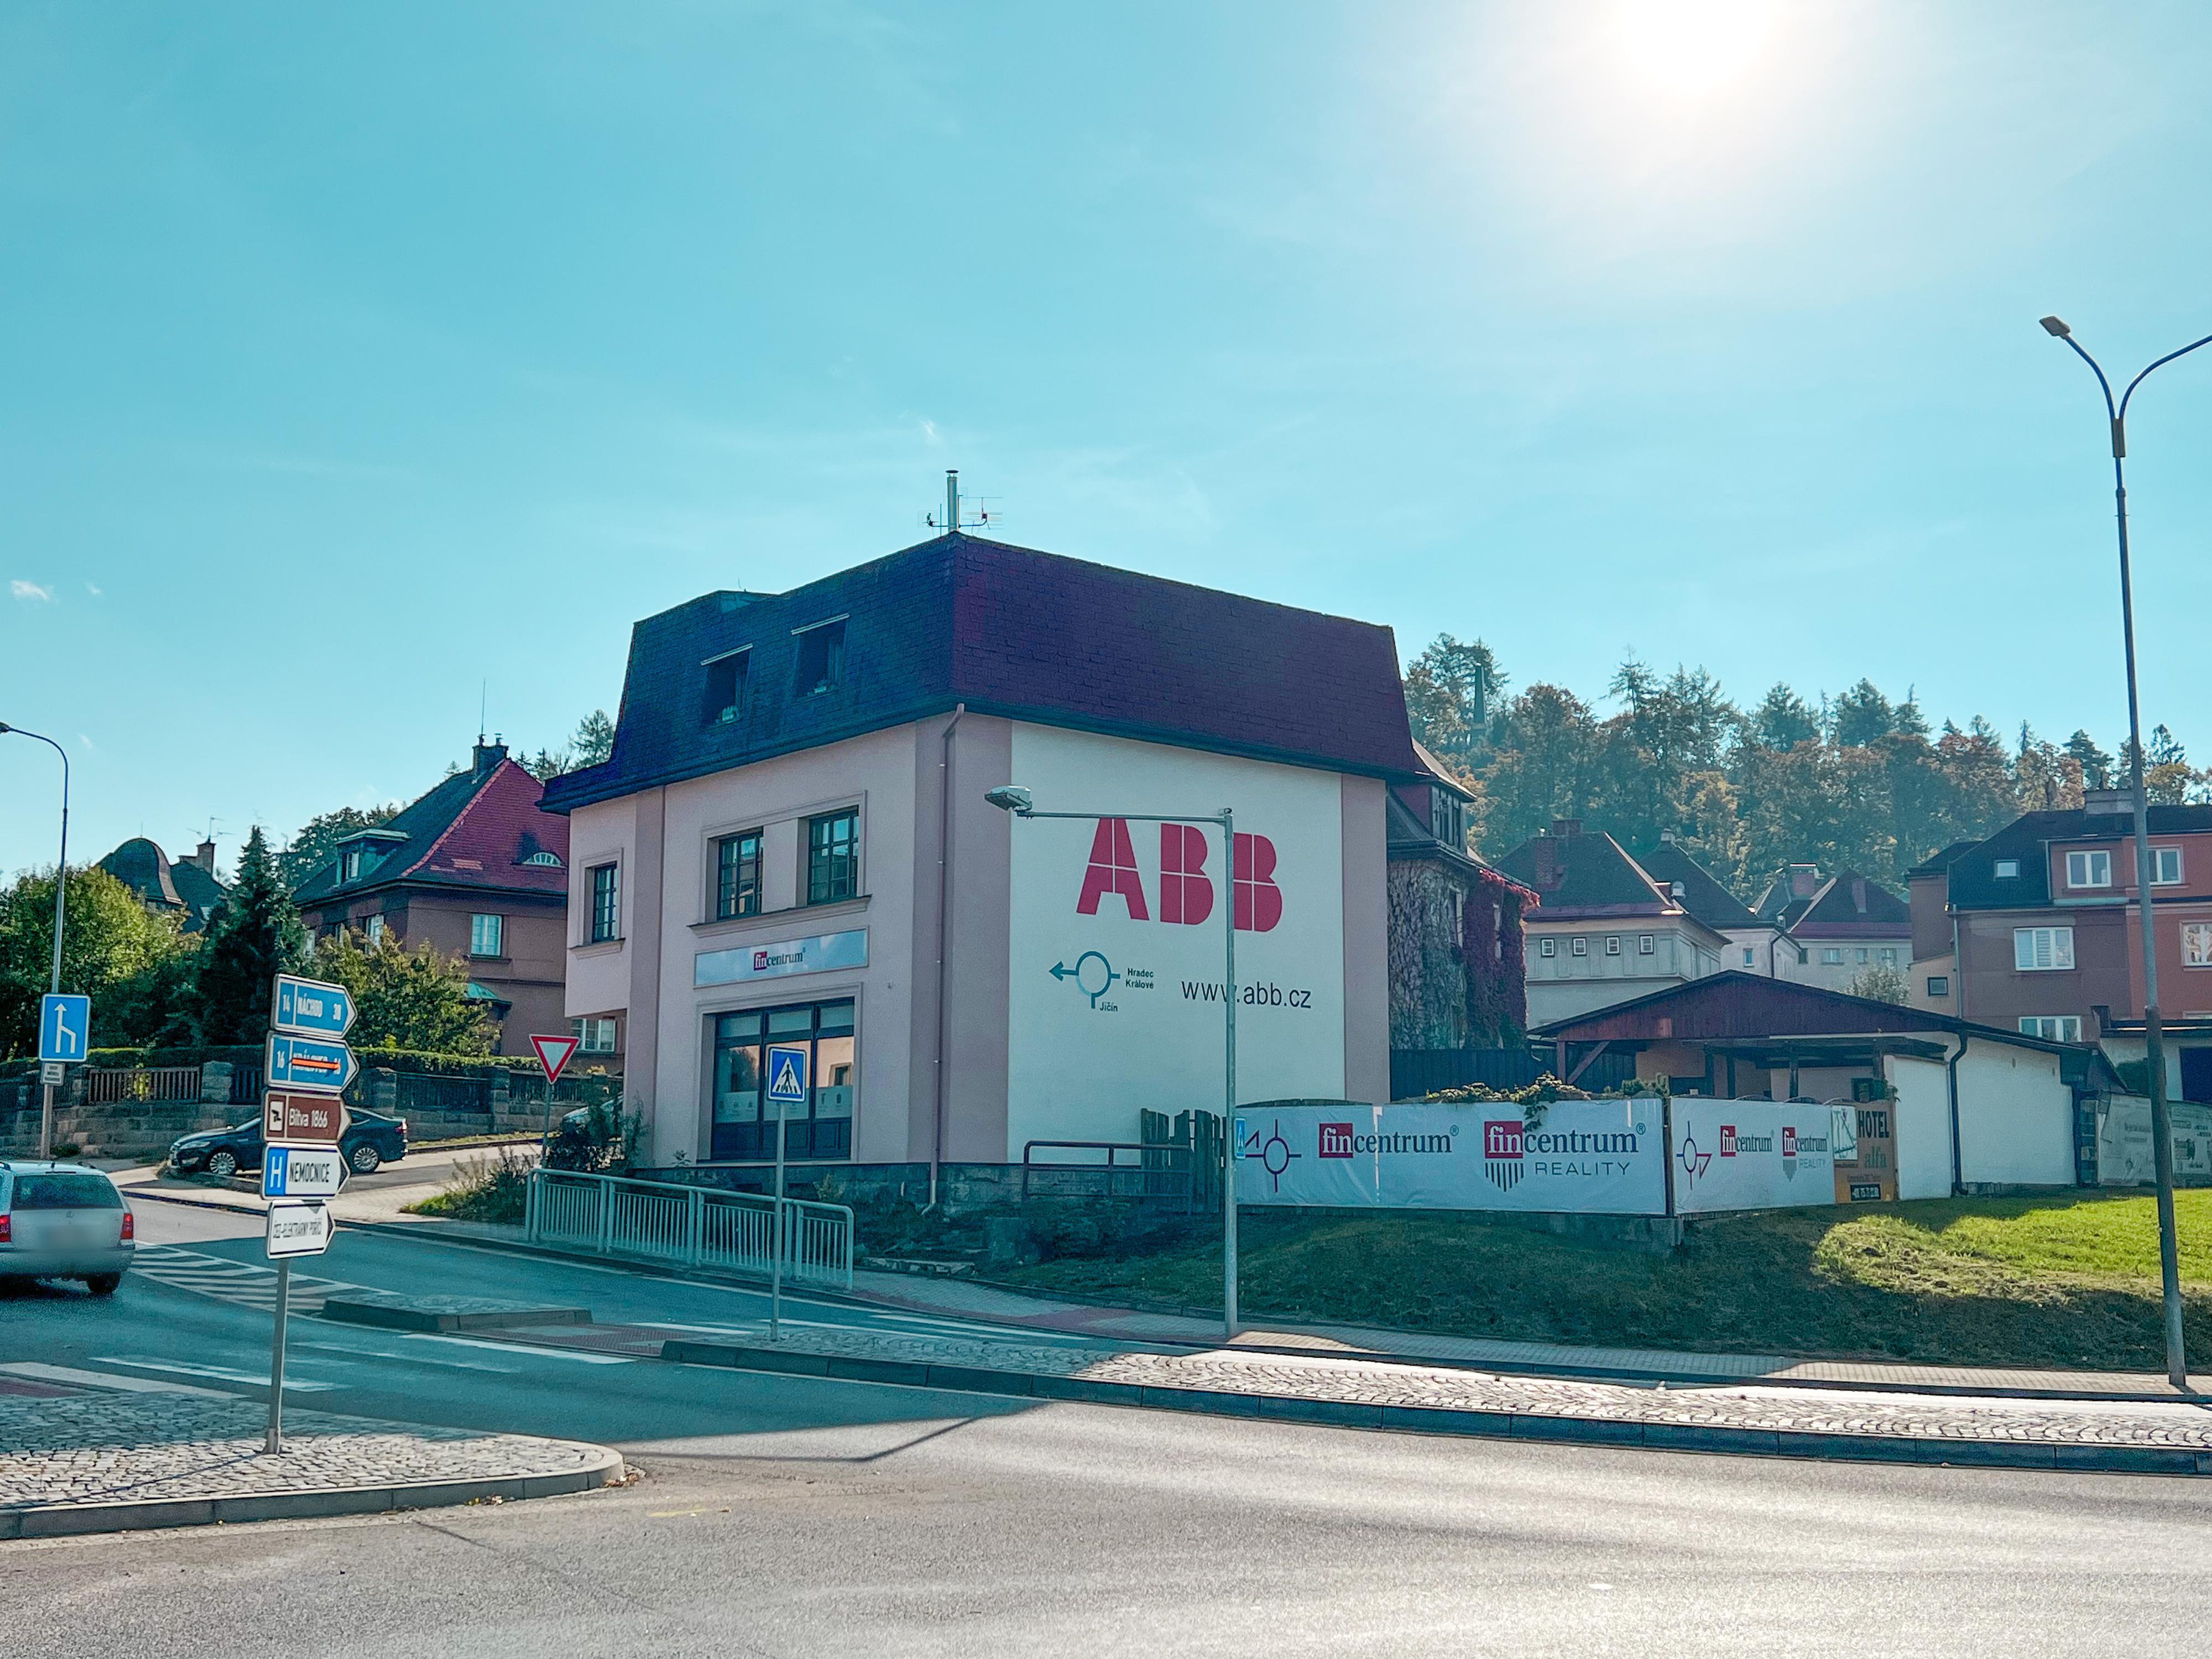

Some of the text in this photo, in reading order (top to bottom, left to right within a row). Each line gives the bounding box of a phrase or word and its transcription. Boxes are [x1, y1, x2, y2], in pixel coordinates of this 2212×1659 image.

[1076, 817, 1282, 932] ABB
[1128, 967, 1154, 978] Hradec
[1125, 979, 1154, 989] Králové
[1100, 1001, 1118, 1012] Jičín
[276, 1050, 285, 1068] 16
[289, 1108, 328, 1128] Bitva 1866
[1858, 1110, 1890, 1139] HOTEL
[269, 1156, 330, 1188] H NEMOCNICE
[1535, 1162, 1630, 1176] REALITY
